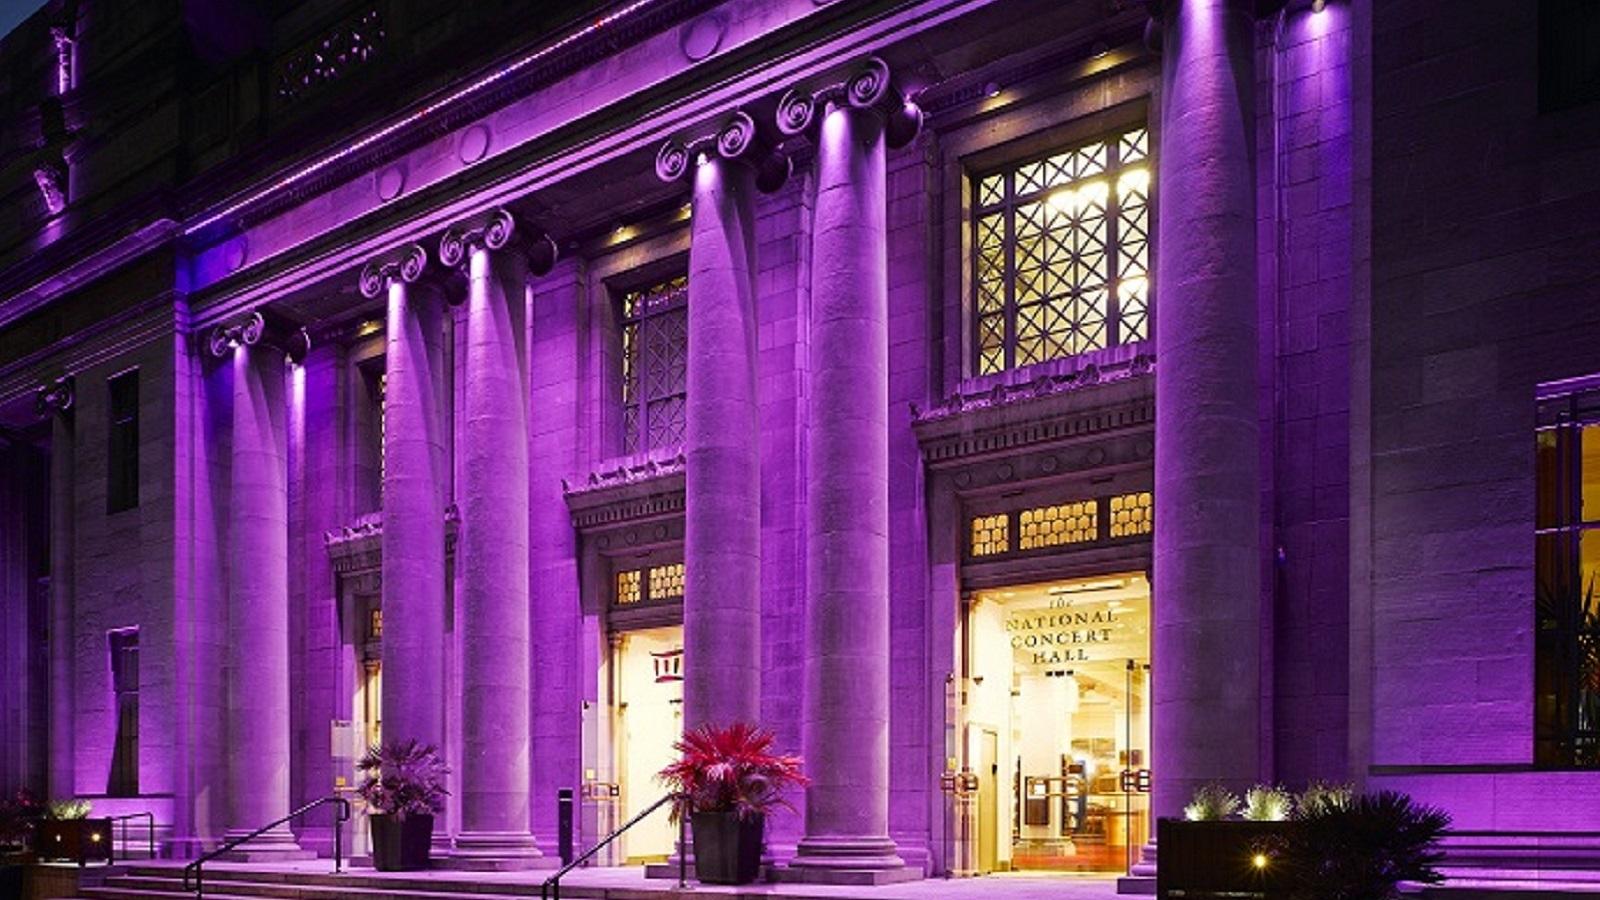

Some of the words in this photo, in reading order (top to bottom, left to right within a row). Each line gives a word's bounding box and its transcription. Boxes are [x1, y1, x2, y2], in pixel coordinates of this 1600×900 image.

[1006, 611, 1117, 631] NATIONAL
[1010, 628, 1112, 648] CONCERT
[1032, 648, 1089, 664] HALL
